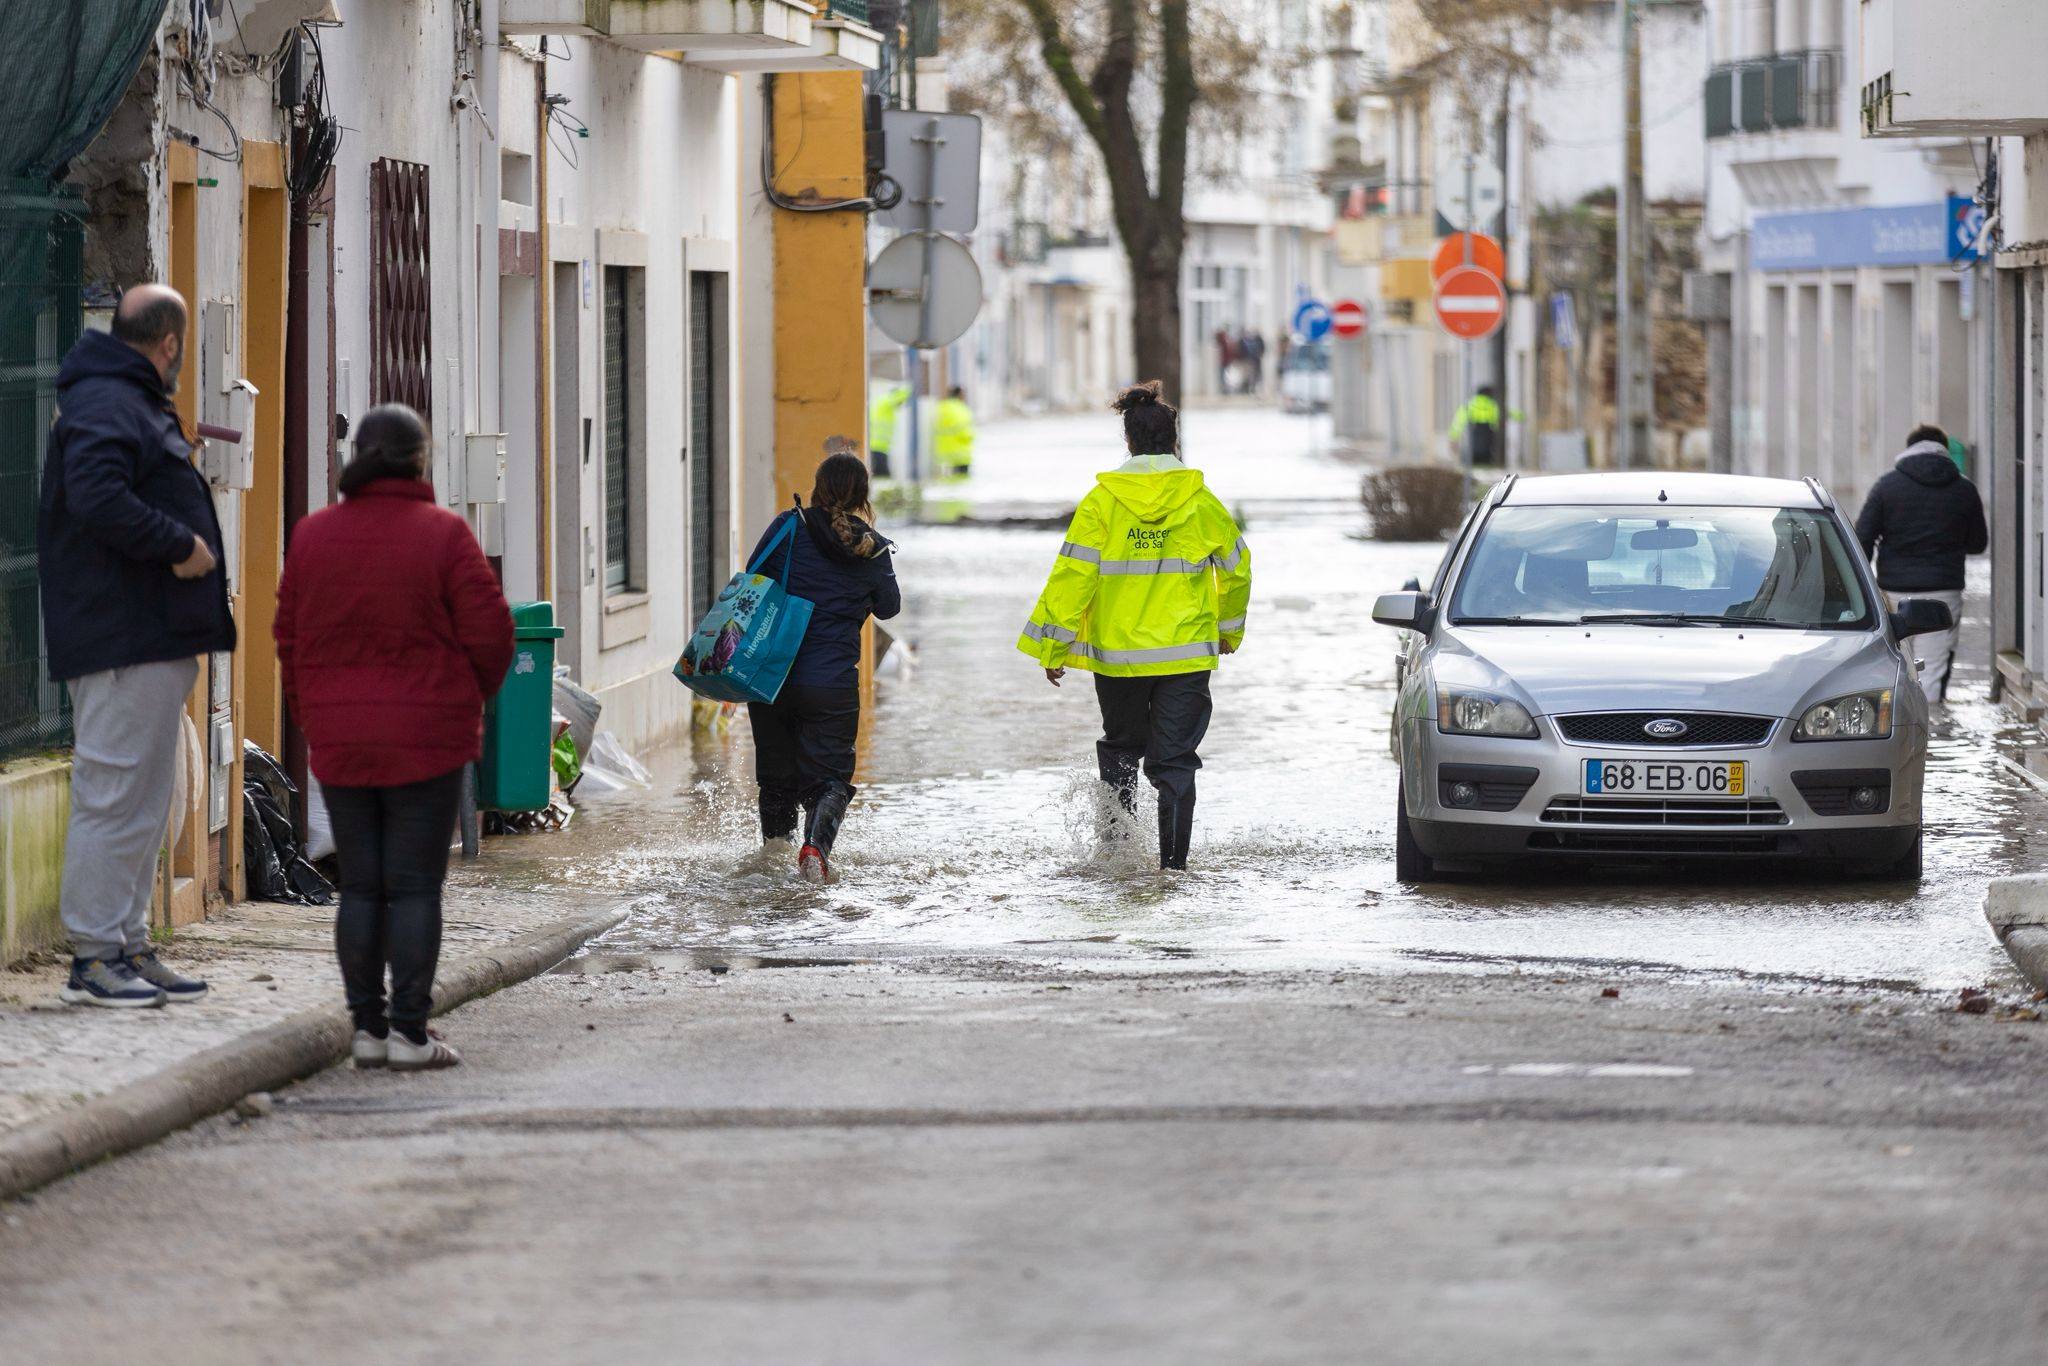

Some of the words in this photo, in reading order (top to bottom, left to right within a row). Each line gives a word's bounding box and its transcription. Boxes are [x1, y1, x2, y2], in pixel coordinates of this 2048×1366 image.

[1127, 528, 1171, 540] Alcácer
[1134, 539, 1149, 549] do
[1653, 722, 1678, 733] Ford
[1730, 766, 1741, 775] 07
[1730, 782, 1741, 792] 07
